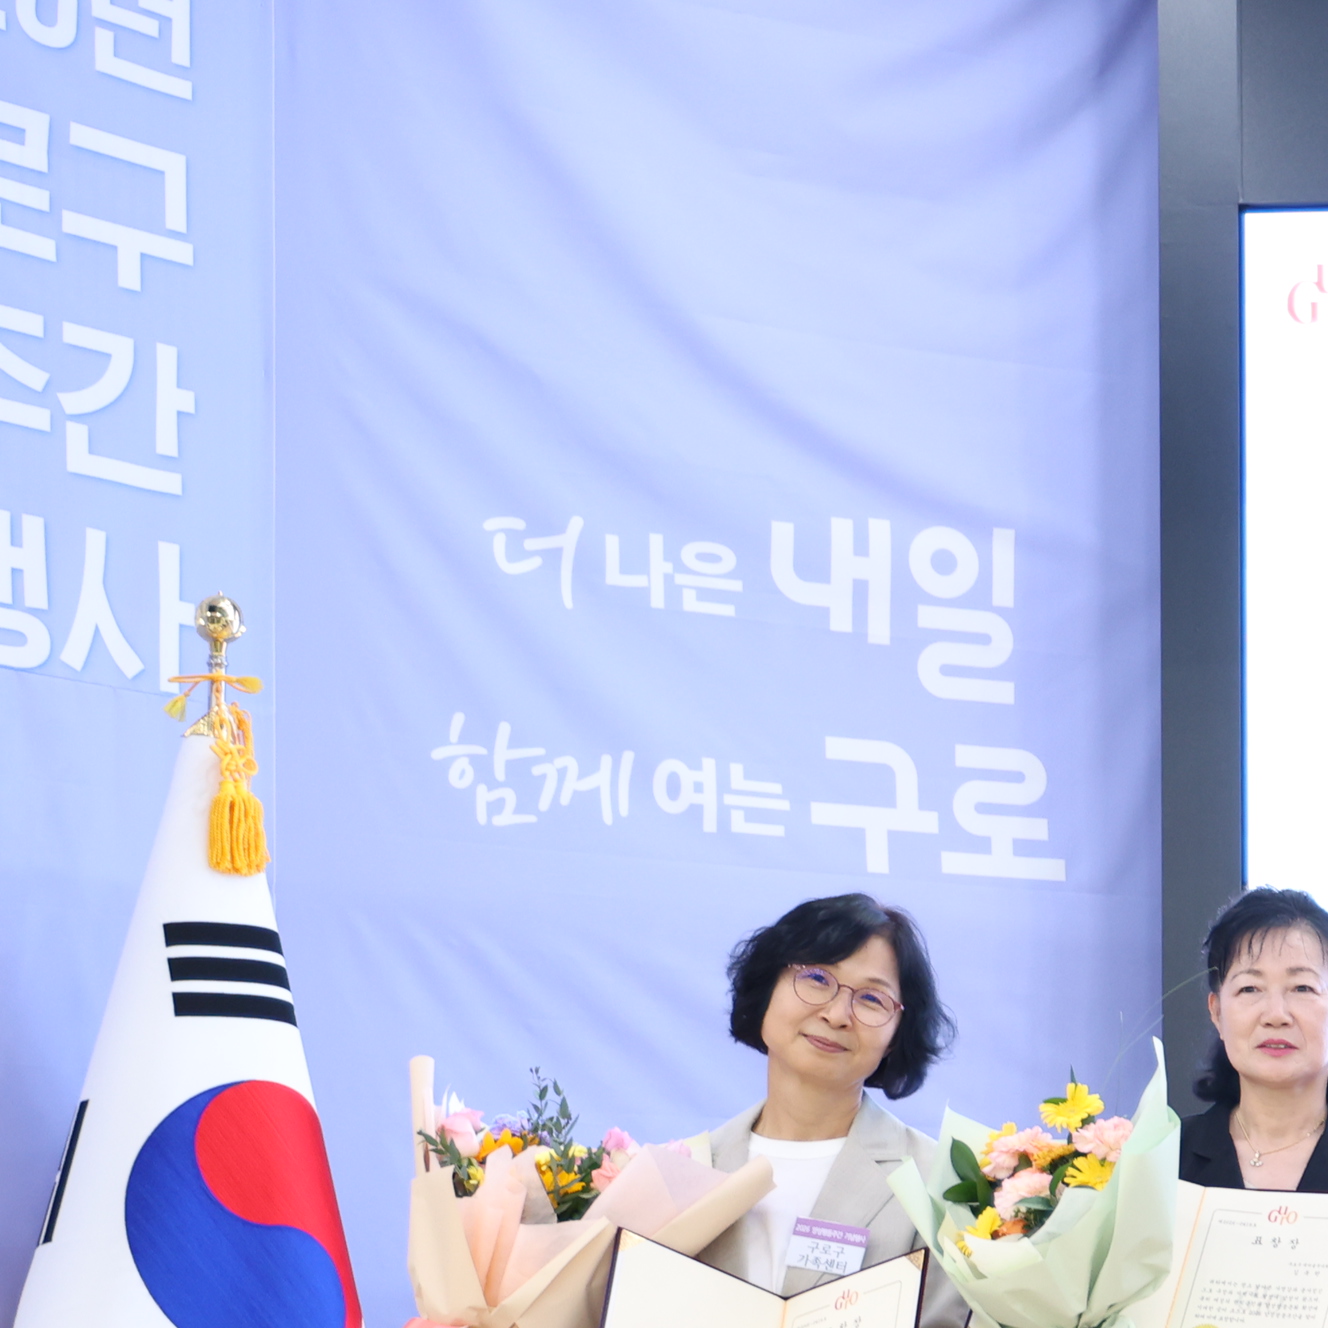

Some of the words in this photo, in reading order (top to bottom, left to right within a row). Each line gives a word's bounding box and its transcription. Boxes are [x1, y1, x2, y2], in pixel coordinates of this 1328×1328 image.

[483, 515, 584, 610] 더
[605, 532, 743, 617] 나은
[770, 516, 1015, 705] 내일
[431, 711, 635, 826] 함께
[652, 756, 790, 837] 여는
[810, 735, 1066, 881] 구로
